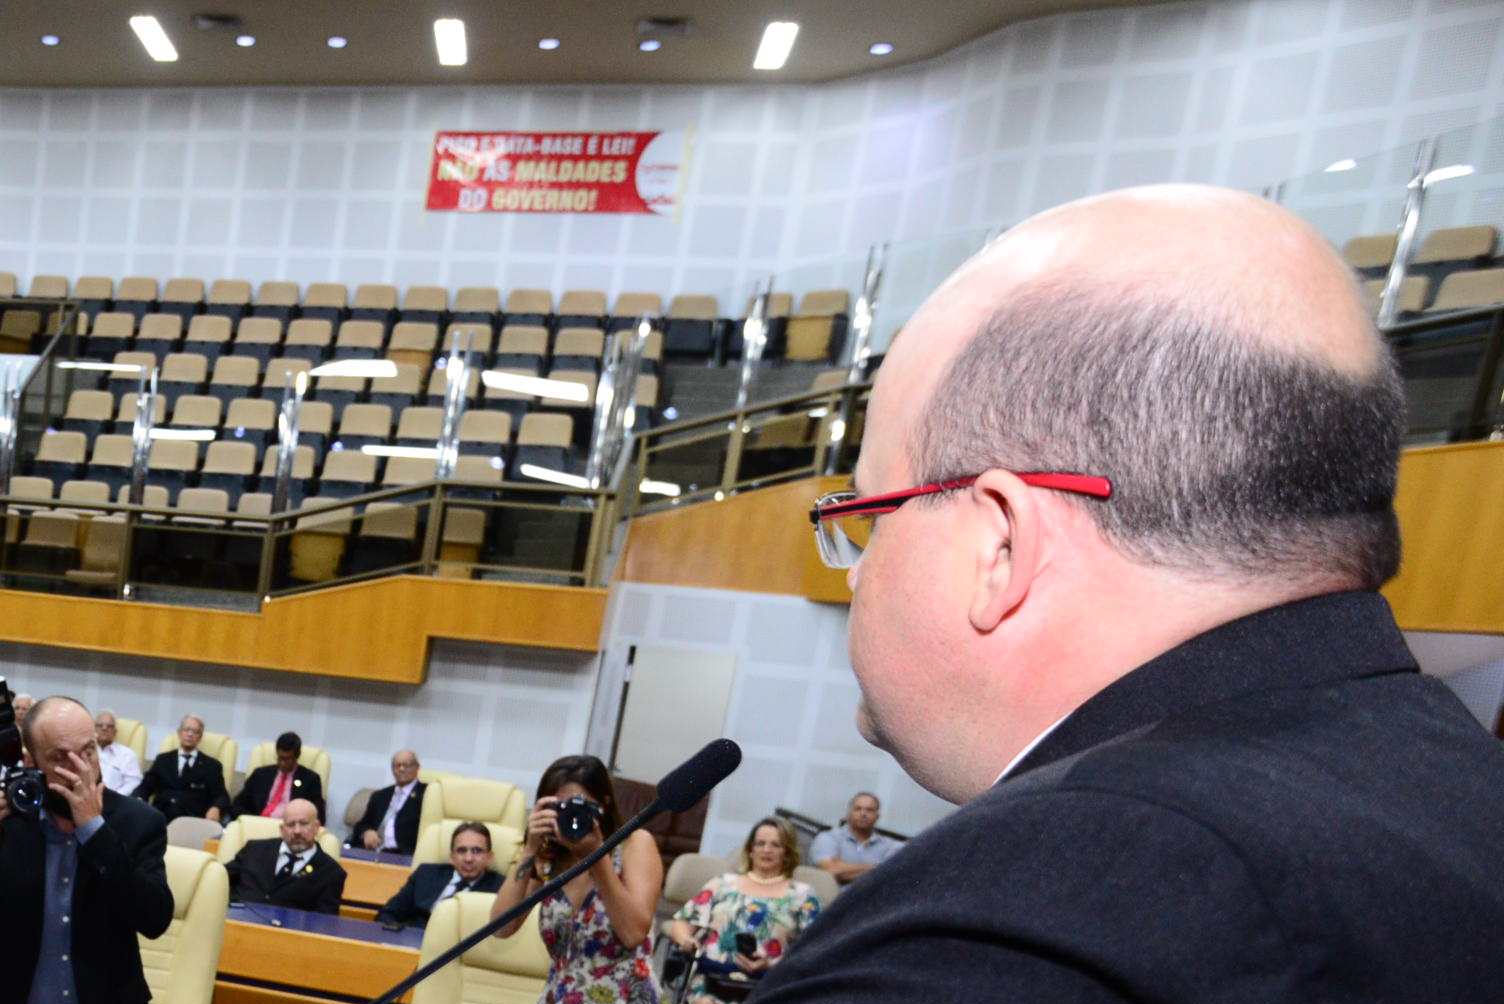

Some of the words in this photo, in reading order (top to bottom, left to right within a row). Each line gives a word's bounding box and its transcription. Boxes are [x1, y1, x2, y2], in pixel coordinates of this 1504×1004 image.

[494, 137, 583, 155] DATA-BASE
[587, 134, 599, 155] É
[515, 157, 629, 183] MALDADES
[458, 188, 488, 210] DO
[491, 187, 599, 212] GOVERNO!
